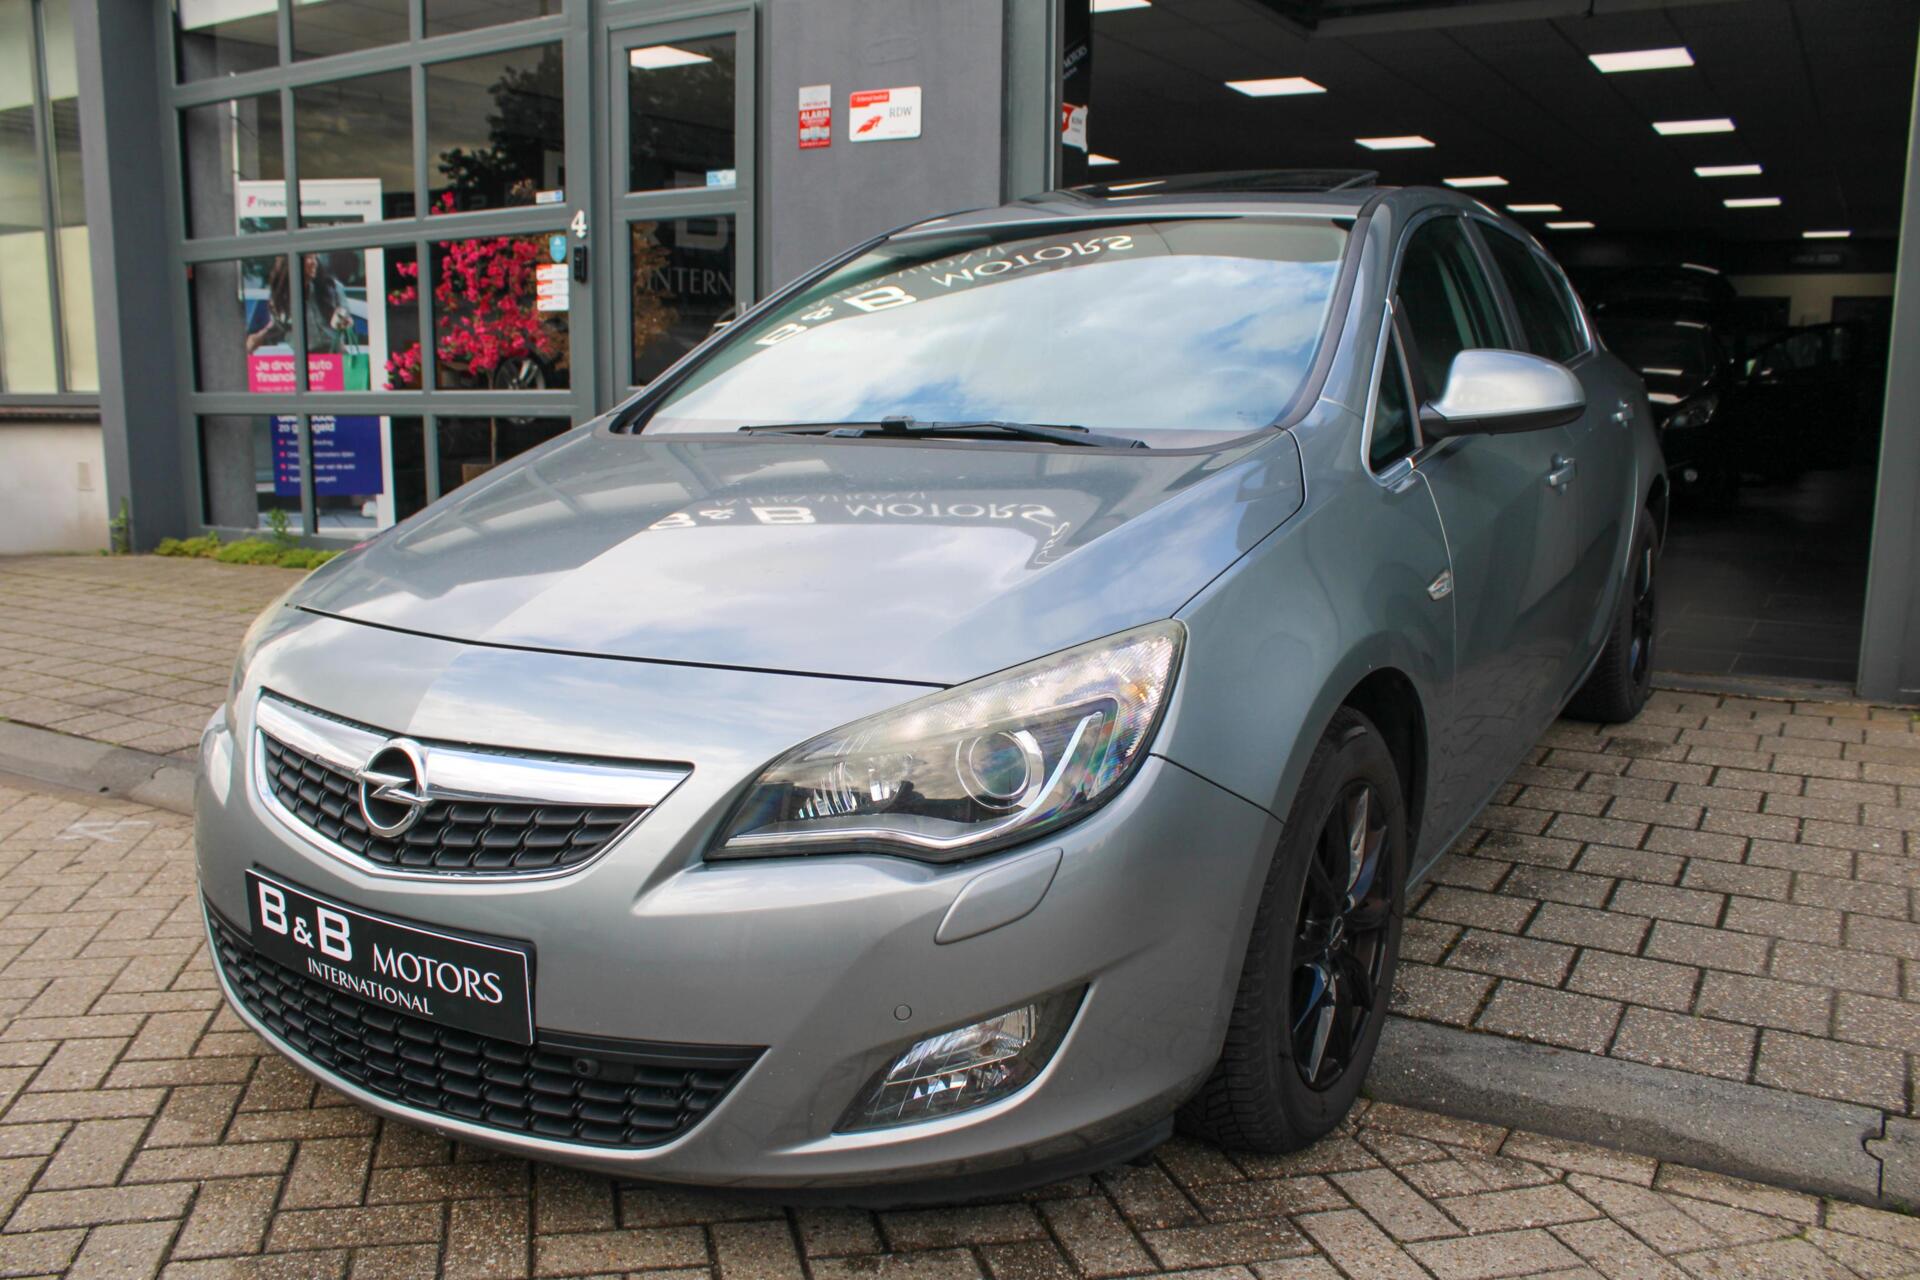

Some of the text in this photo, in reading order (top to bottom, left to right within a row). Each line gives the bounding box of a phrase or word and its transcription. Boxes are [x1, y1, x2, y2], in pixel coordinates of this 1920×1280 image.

[801, 109, 830, 121] ALARM
[889, 106, 913, 118] RDW
[571, 209, 587, 238] 4
[307, 957, 434, 1016] INTERNATIONAL
[373, 943, 503, 1004] MOTORS
